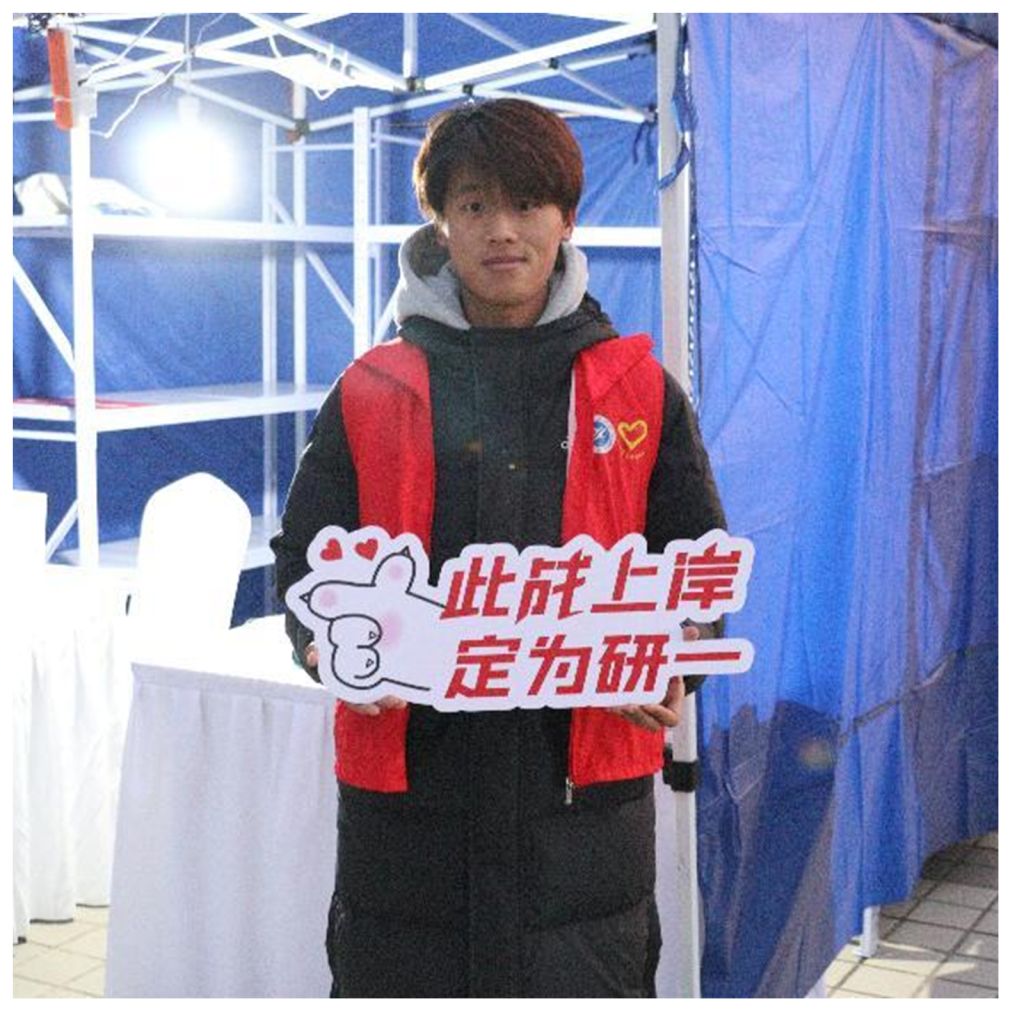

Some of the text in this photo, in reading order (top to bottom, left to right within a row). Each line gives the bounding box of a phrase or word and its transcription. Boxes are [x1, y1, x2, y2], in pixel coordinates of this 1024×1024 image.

[439, 543, 742, 625] 此战上岸
[444, 633, 742, 699] 定为研一
